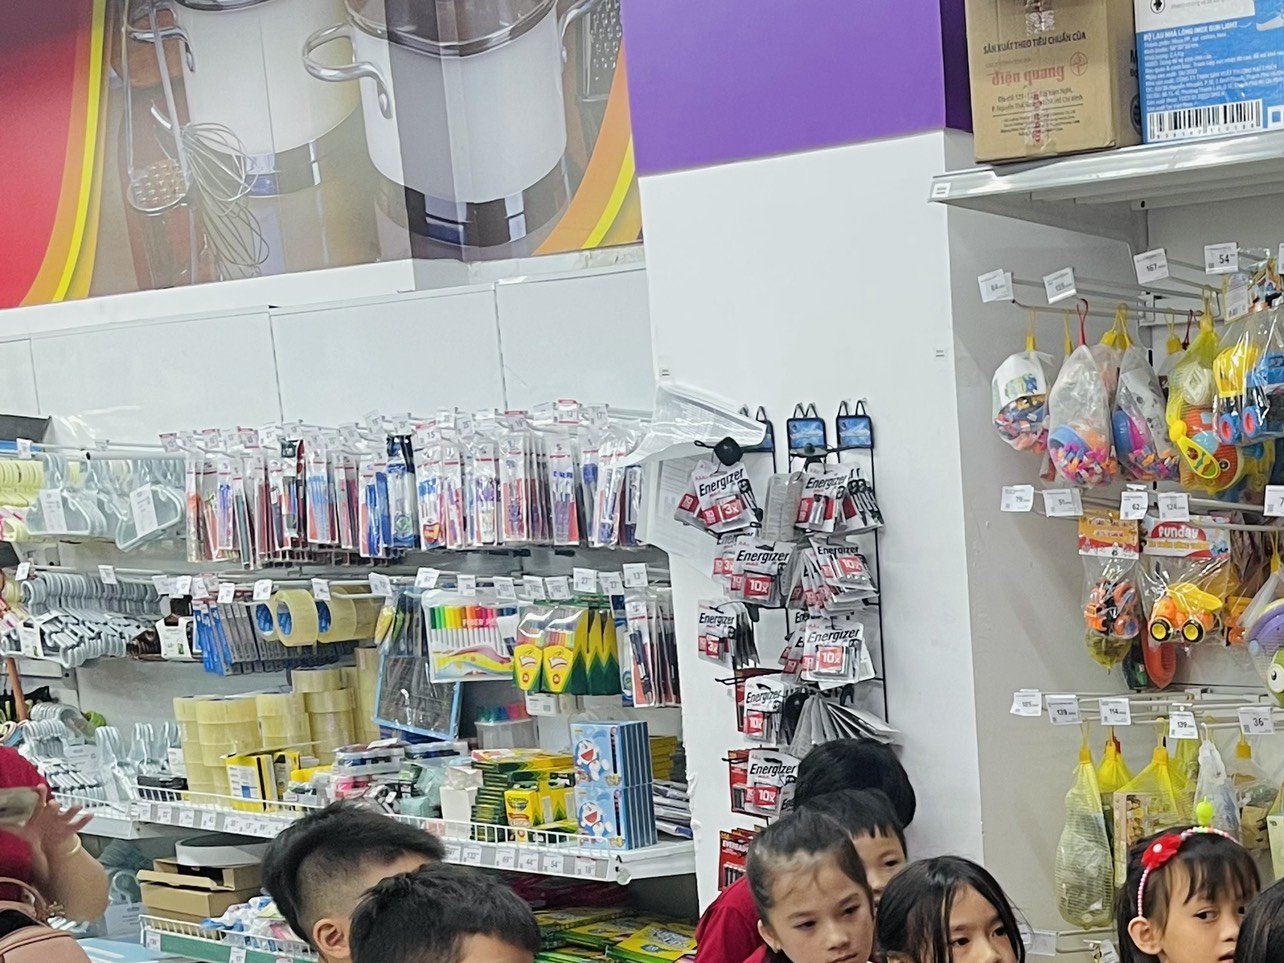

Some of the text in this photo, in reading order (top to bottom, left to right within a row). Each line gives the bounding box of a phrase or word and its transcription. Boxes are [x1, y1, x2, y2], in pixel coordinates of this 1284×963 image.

[1014, 38, 1032, 49] THEO
[990, 66, 1065, 87] điện quang
[1219, 254, 1229, 264] 54
[698, 468, 745, 497] Energizer
[805, 474, 848, 490] Energizer
[723, 501, 740, 515] 3x
[1132, 503, 1140, 511] 62
[736, 549, 790, 565] Energizer
[749, 578, 770, 593] 10x
[699, 612, 735, 626] Energizer
[807, 628, 861, 644] Energizer
[822, 651, 841, 664] 10x
[1252, 717, 1264, 727] 36
[749, 763, 797, 777] Energizer
[758, 789, 777, 803] 10x
